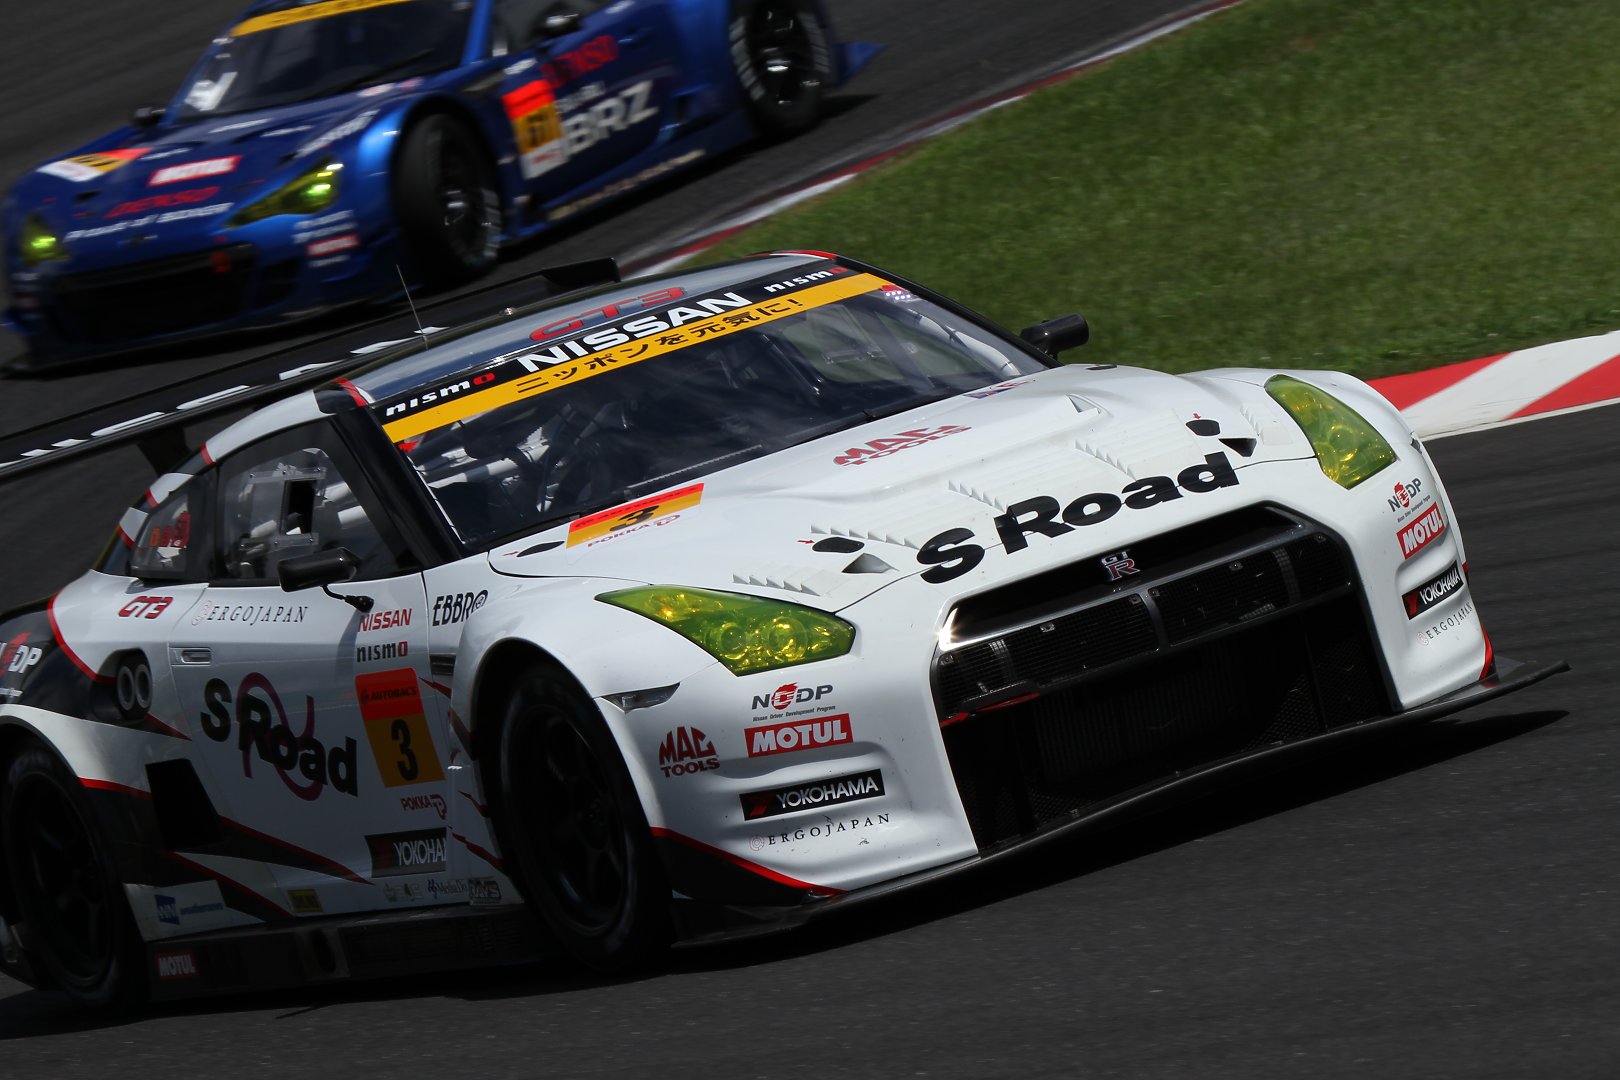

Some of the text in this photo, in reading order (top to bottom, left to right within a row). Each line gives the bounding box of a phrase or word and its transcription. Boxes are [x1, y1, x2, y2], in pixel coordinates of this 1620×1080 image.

[560, 80, 660, 156] BRZ
[764, 265, 848, 293] nismo
[530, 286, 686, 342] GT3
[517, 292, 754, 374] NISSAN
[384, 371, 497, 417] nismo
[608, 504, 661, 532] 3
[915, 450, 1240, 585] S Road
[1402, 507, 1444, 555] MOTUL
[587, 523, 650, 548] POKKA
[1419, 568, 1461, 605] YOKOHAMA
[118, 595, 174, 620] GT3
[206, 605, 309, 626] ERGOJAPAN
[357, 607, 412, 633] NISSAN
[356, 641, 408, 663] nismo
[371, 685, 417, 702] AUTOBACS
[200, 677, 359, 799] S Road
[391, 718, 419, 781] 3
[658, 726, 718, 766] MAC
[752, 719, 848, 754] MOTUL
[660, 757, 721, 779] TOOLS
[400, 794, 433, 812] POKKA
[775, 776, 880, 810] YOKOHAMA
[767, 813, 890, 846] ERGOJAPAN
[392, 838, 447, 866] YOKOHA
[157, 954, 197, 977] MOTUL
